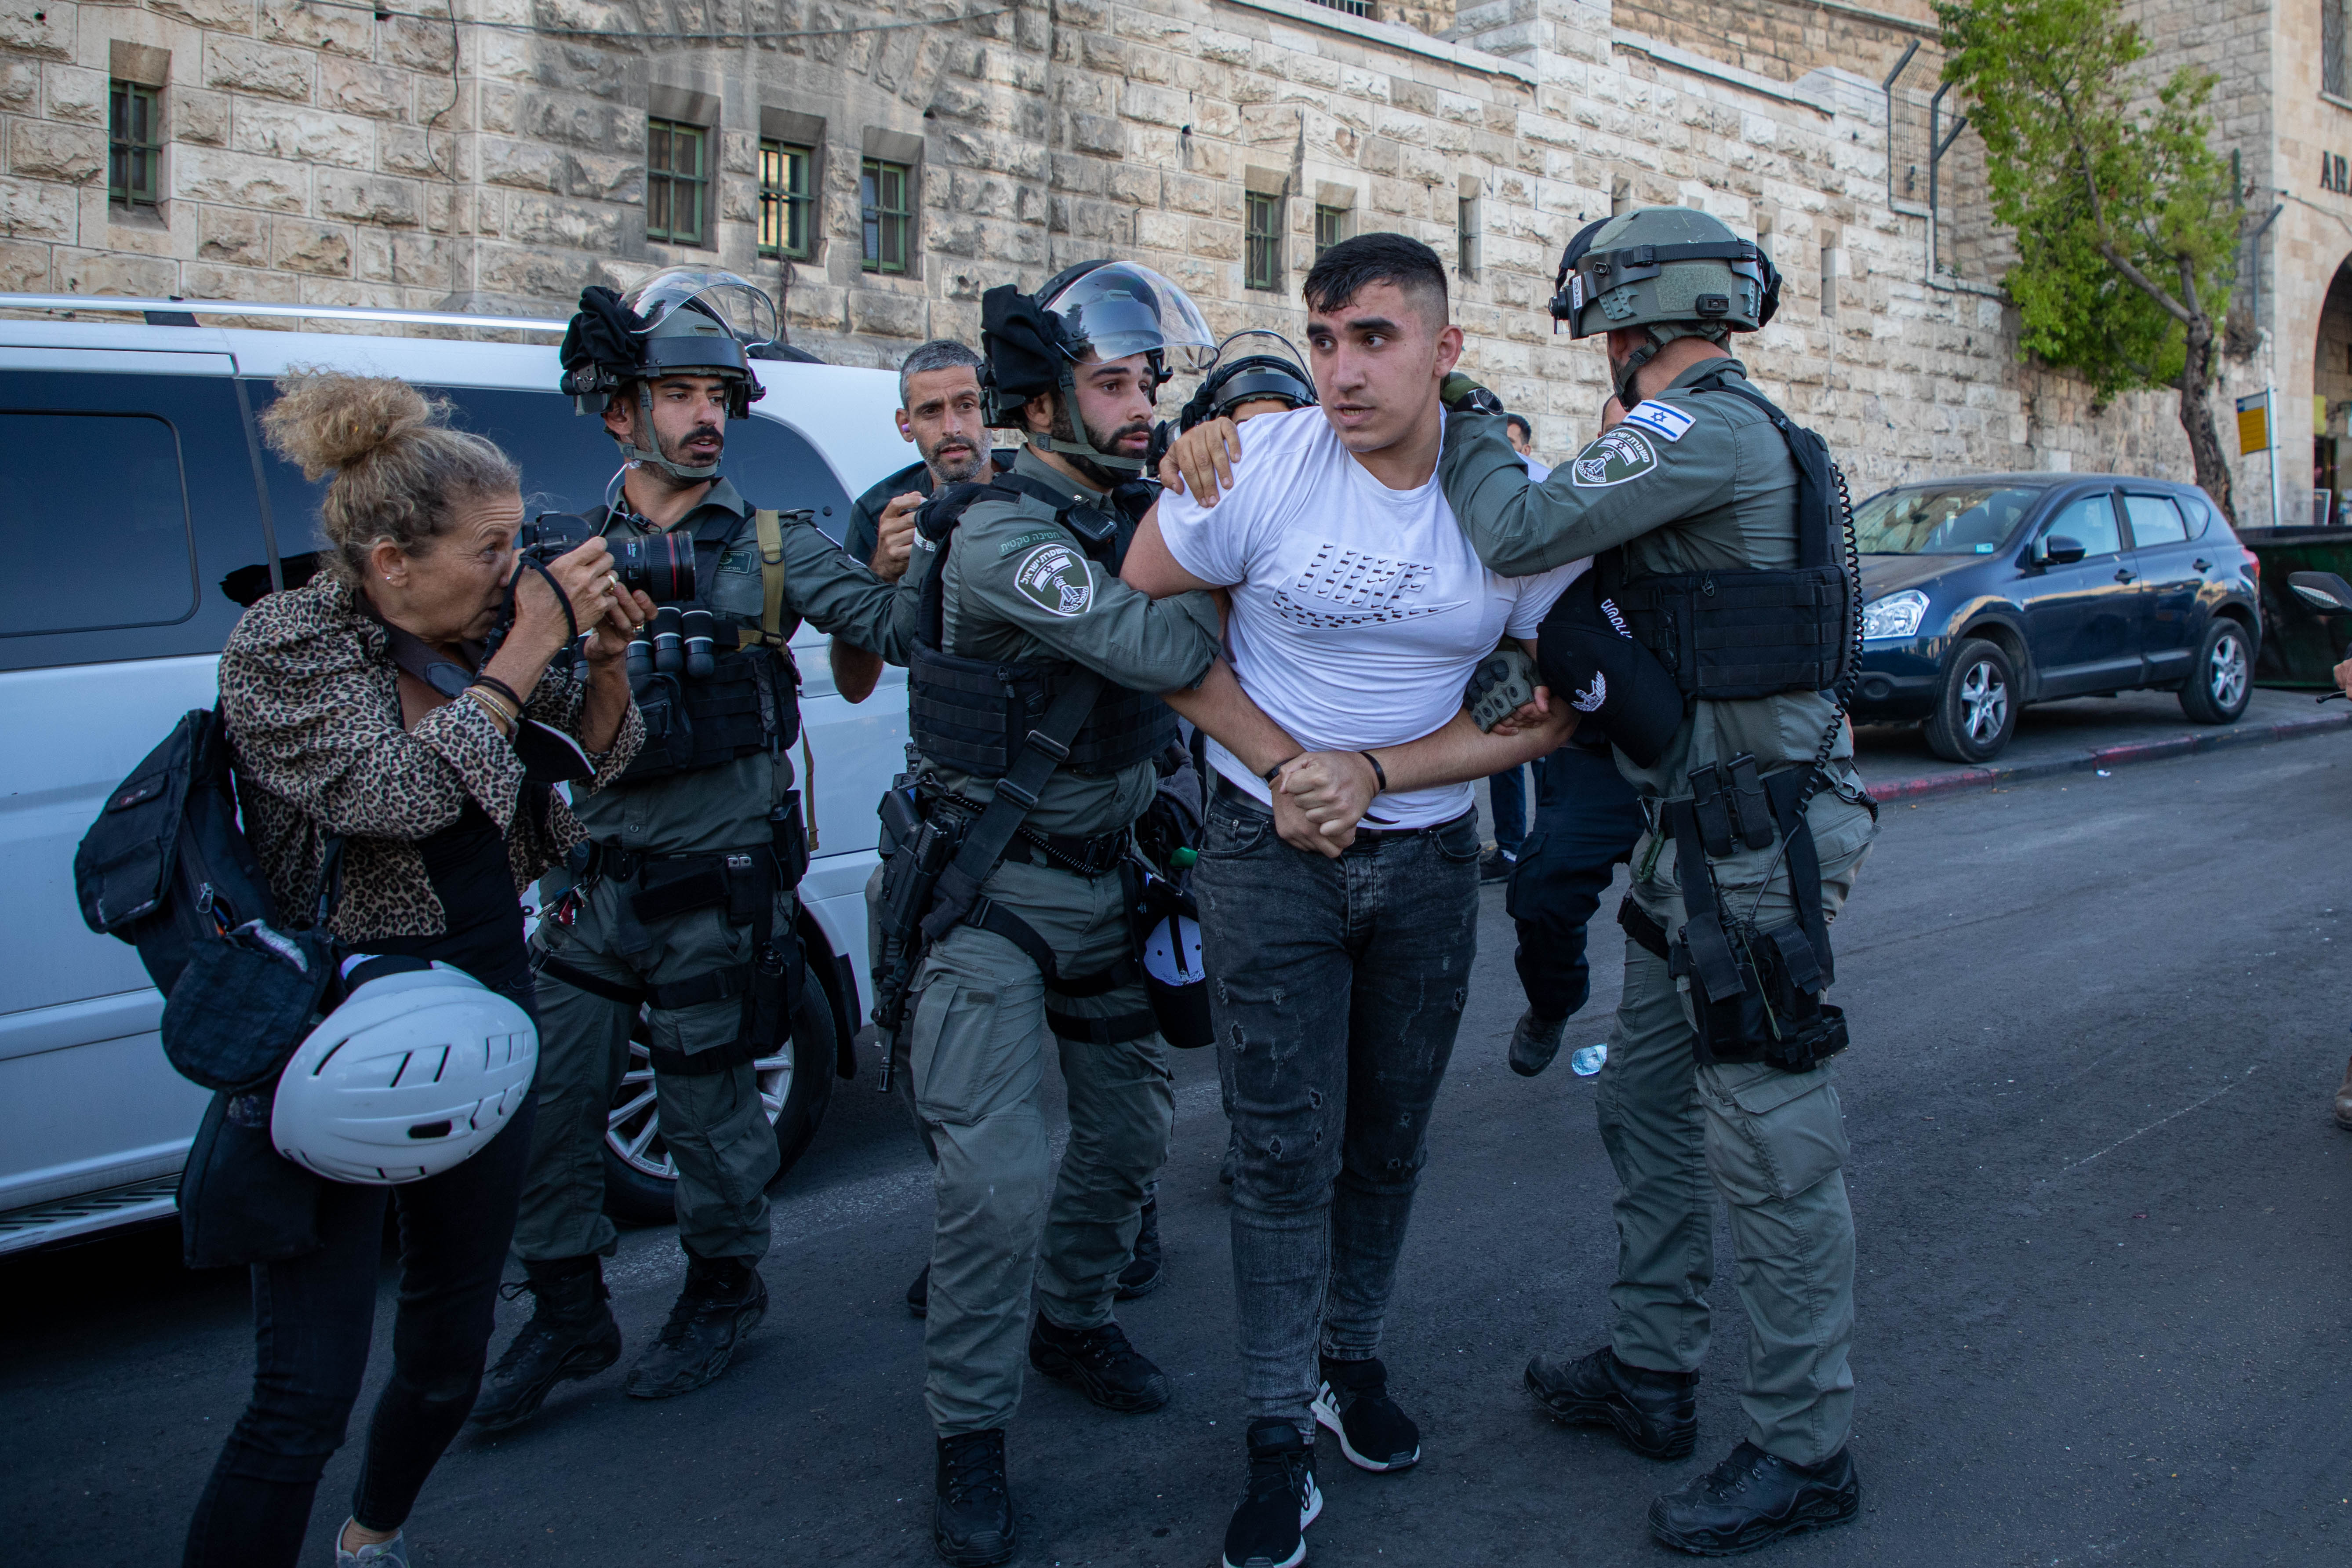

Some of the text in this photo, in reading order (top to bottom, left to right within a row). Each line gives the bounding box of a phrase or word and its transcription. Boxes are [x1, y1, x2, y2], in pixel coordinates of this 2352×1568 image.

[2319, 149, 2352, 196] AR
[1628, 437, 1650, 463] משטרת
[1000, 531, 1061, 552] חטיבה טקטית
[1020, 548, 1069, 584] משטרת ישראל
[1294, 542, 1434, 610] NIKE
